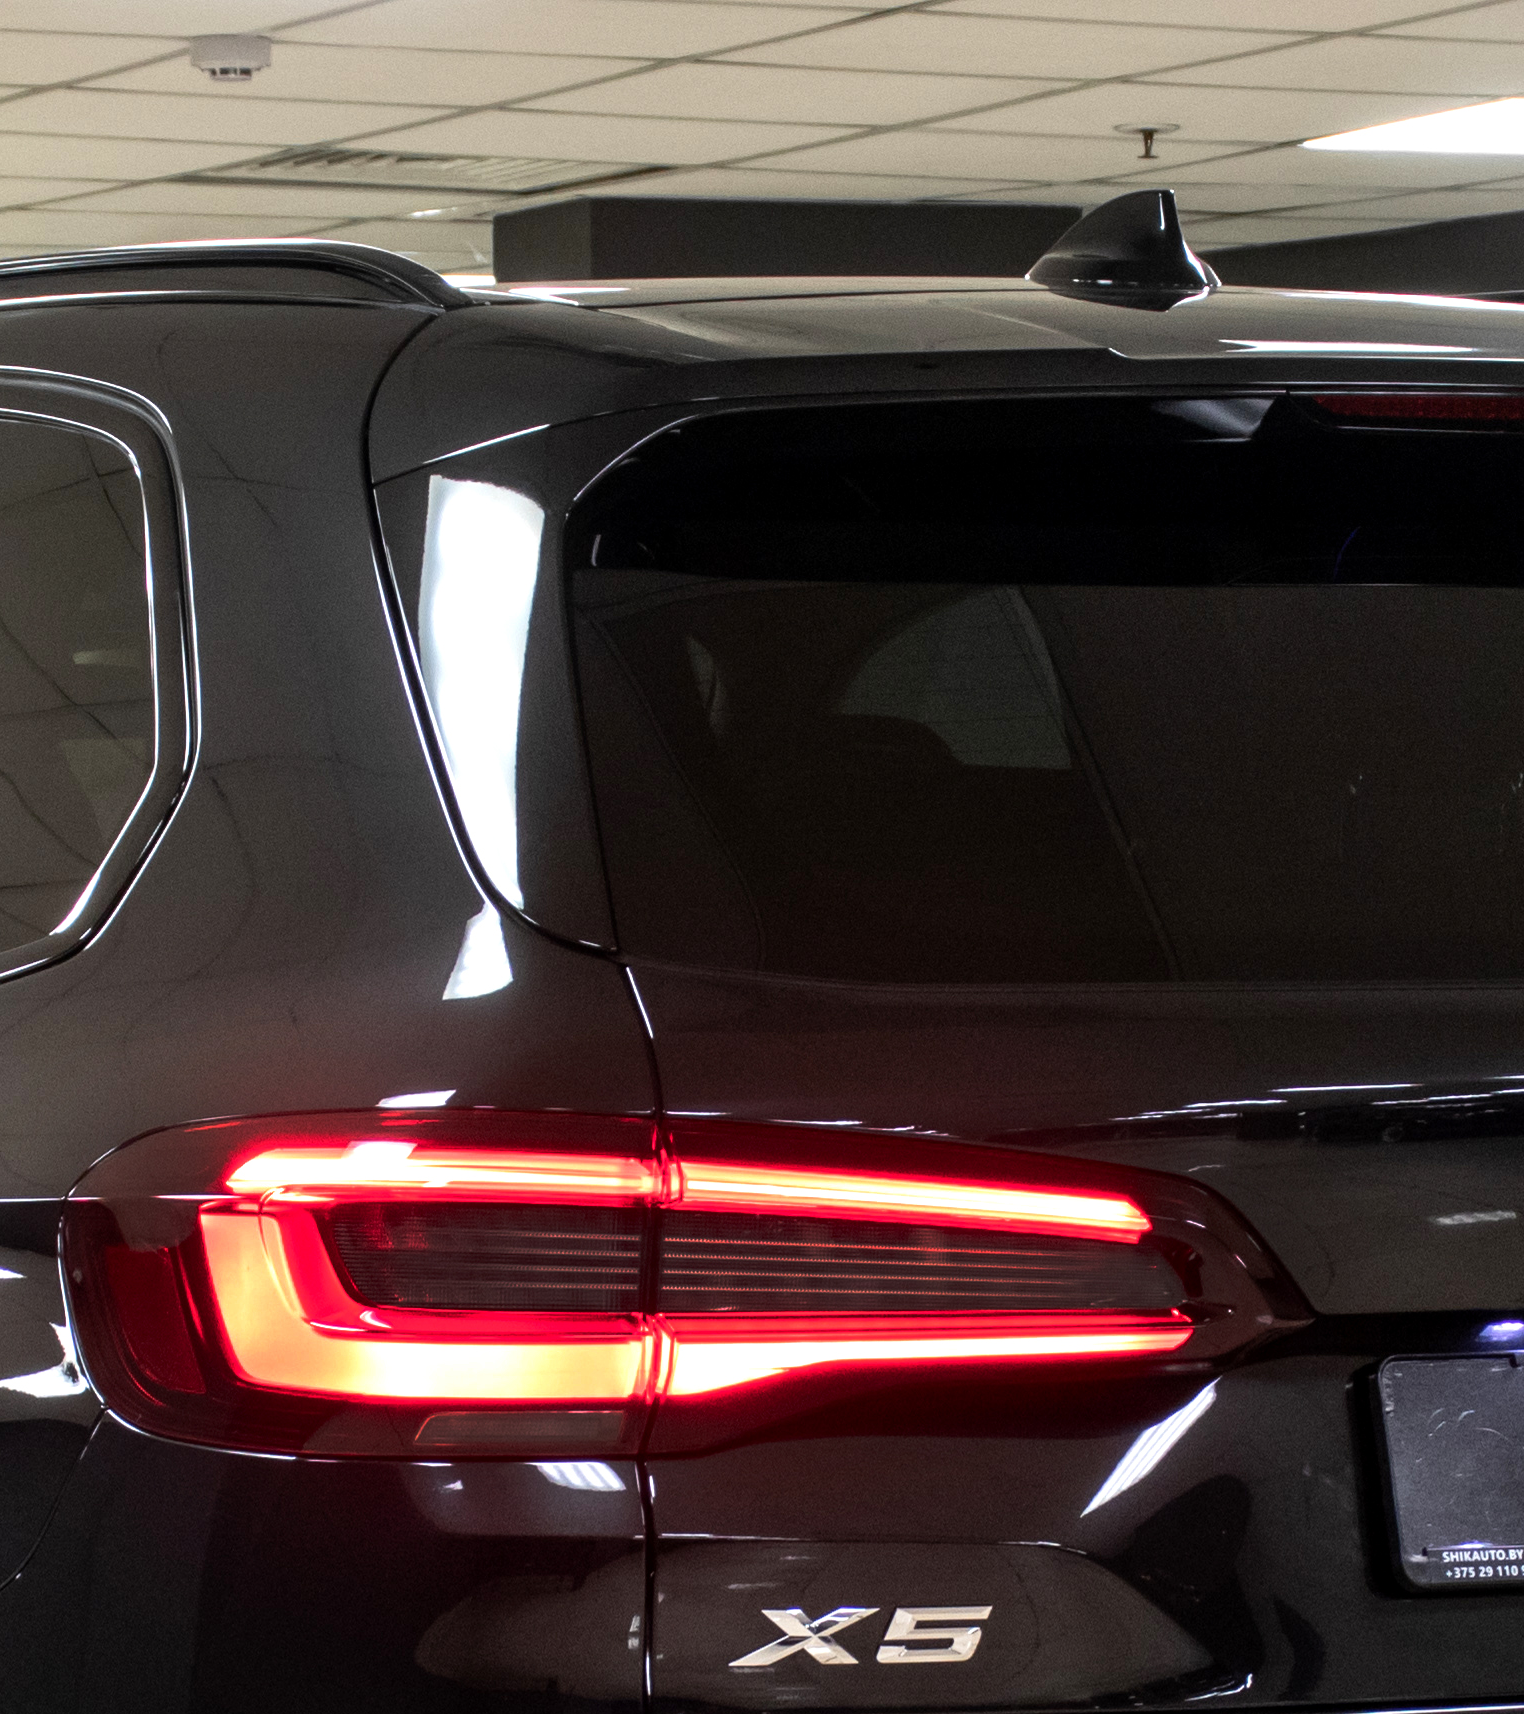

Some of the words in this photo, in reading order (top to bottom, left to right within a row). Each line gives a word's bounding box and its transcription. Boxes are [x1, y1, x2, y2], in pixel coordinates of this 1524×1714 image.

[1442, 1549, 1524, 1563] SHIKAUTO.BY
[1446, 1567, 1476, 1578] +375
[1478, 1566, 1493, 1577] 29
[1497, 1565, 1518, 1576] 110
[728, 1605, 993, 1666] X5
